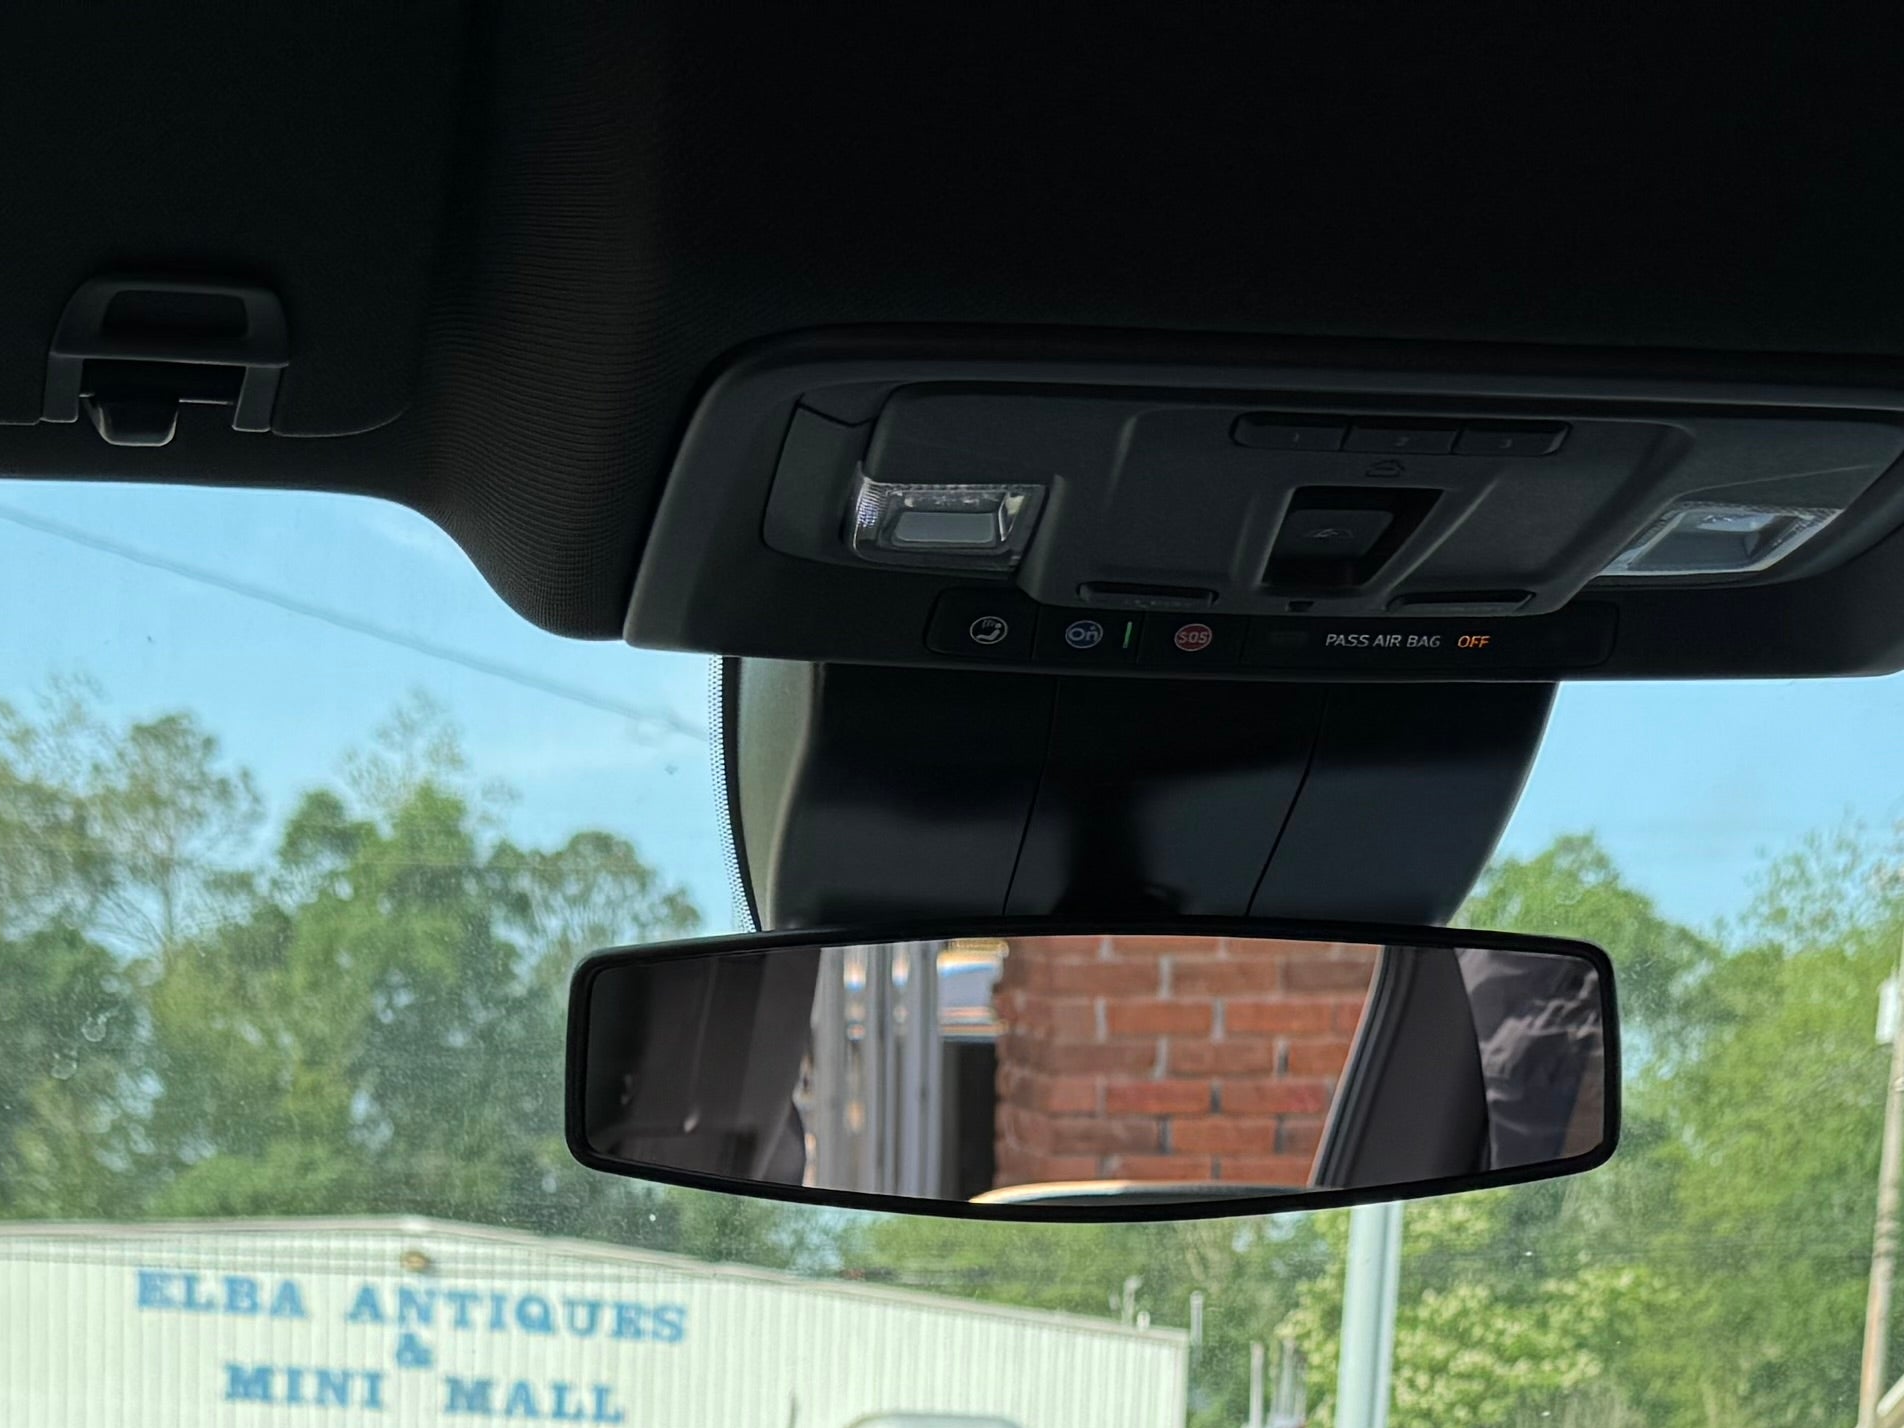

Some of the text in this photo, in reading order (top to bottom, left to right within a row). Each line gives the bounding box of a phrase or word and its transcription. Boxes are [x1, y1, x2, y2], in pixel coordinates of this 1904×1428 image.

[1179, 630, 1210, 644] SOS
[1325, 633, 1491, 649] PASS AIR BAG OFF
[135, 1267, 688, 1343] ELBA ANTIQUES
[394, 1333, 434, 1370] &
[223, 1363, 625, 1425] MINI MALL
